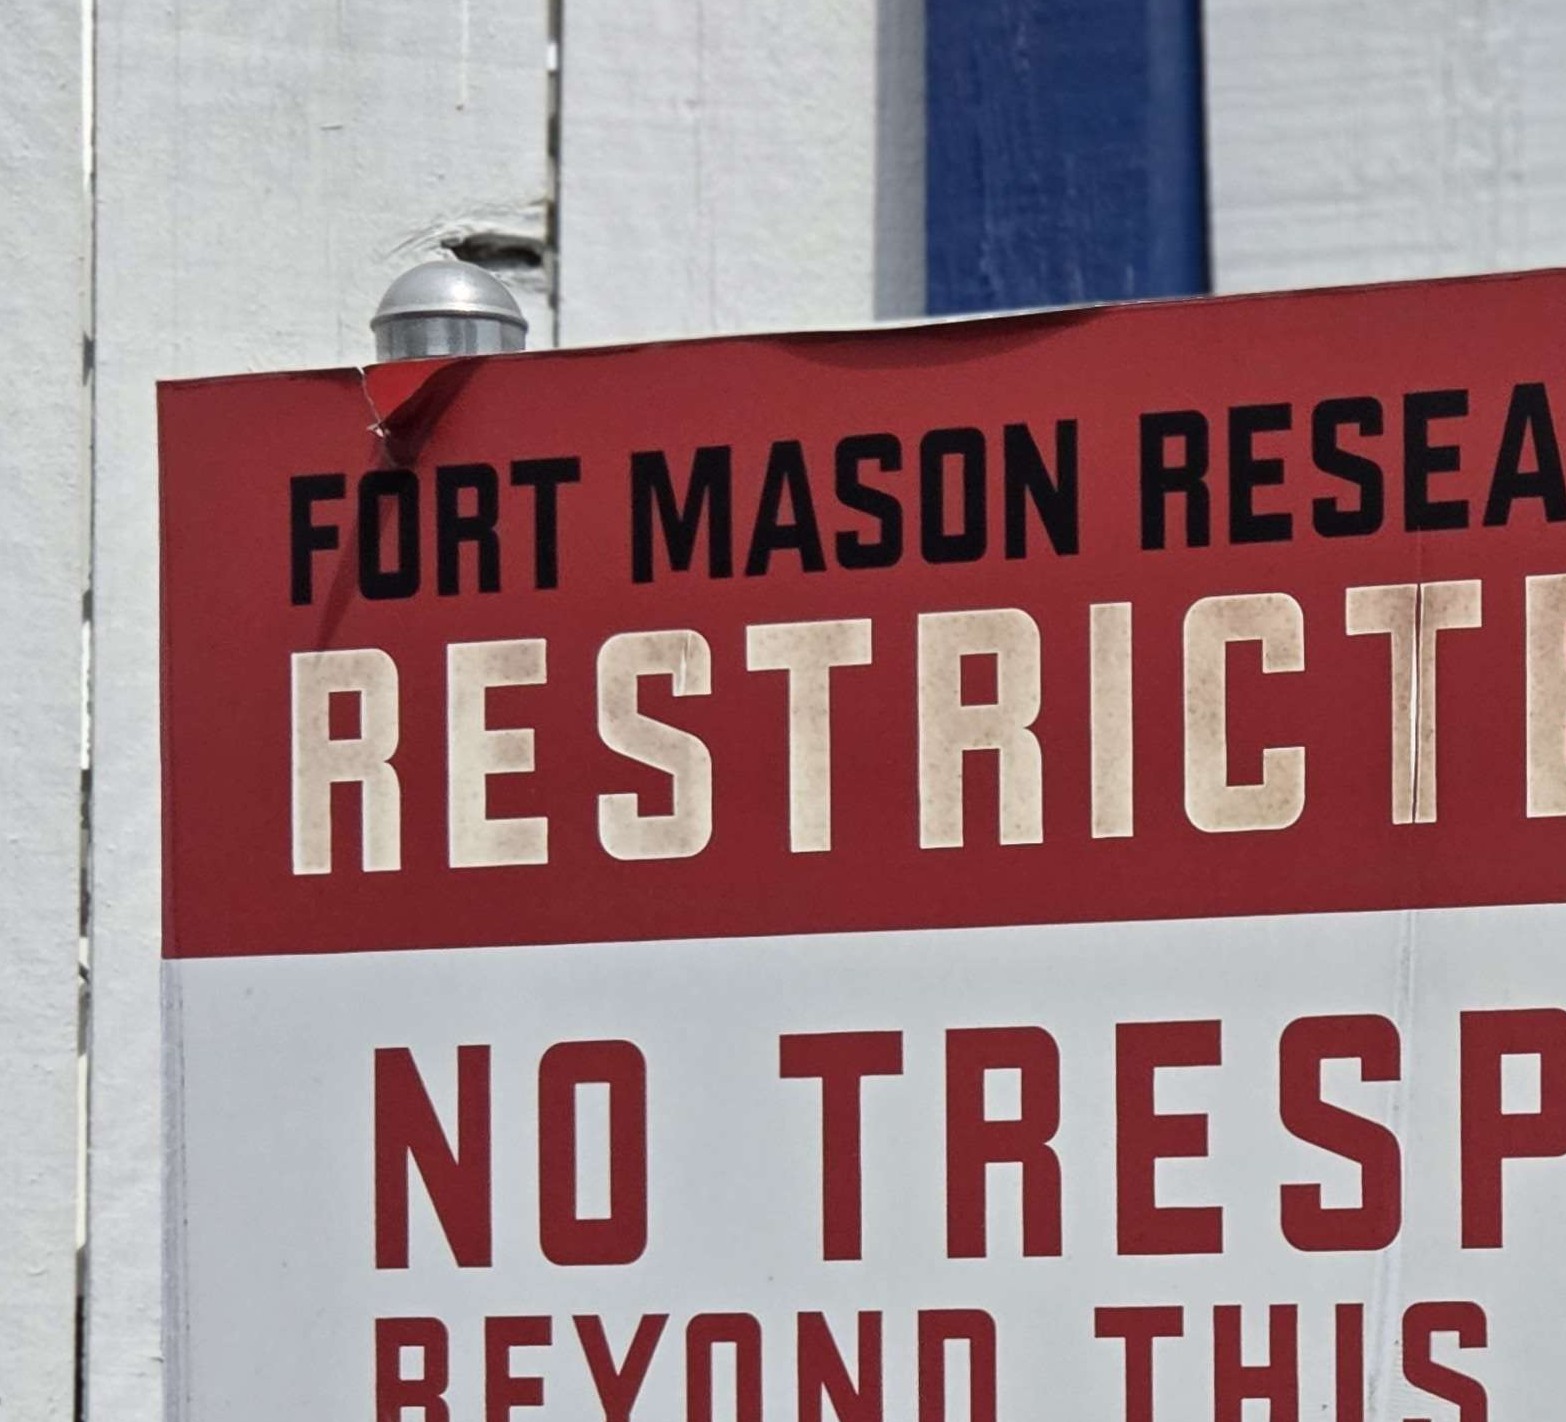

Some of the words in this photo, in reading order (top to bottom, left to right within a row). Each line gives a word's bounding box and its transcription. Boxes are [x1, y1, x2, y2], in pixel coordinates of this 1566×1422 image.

[291, 456, 580, 605] FORT
[631, 420, 1078, 584] MASON
[376, 1041, 646, 1268] NO
